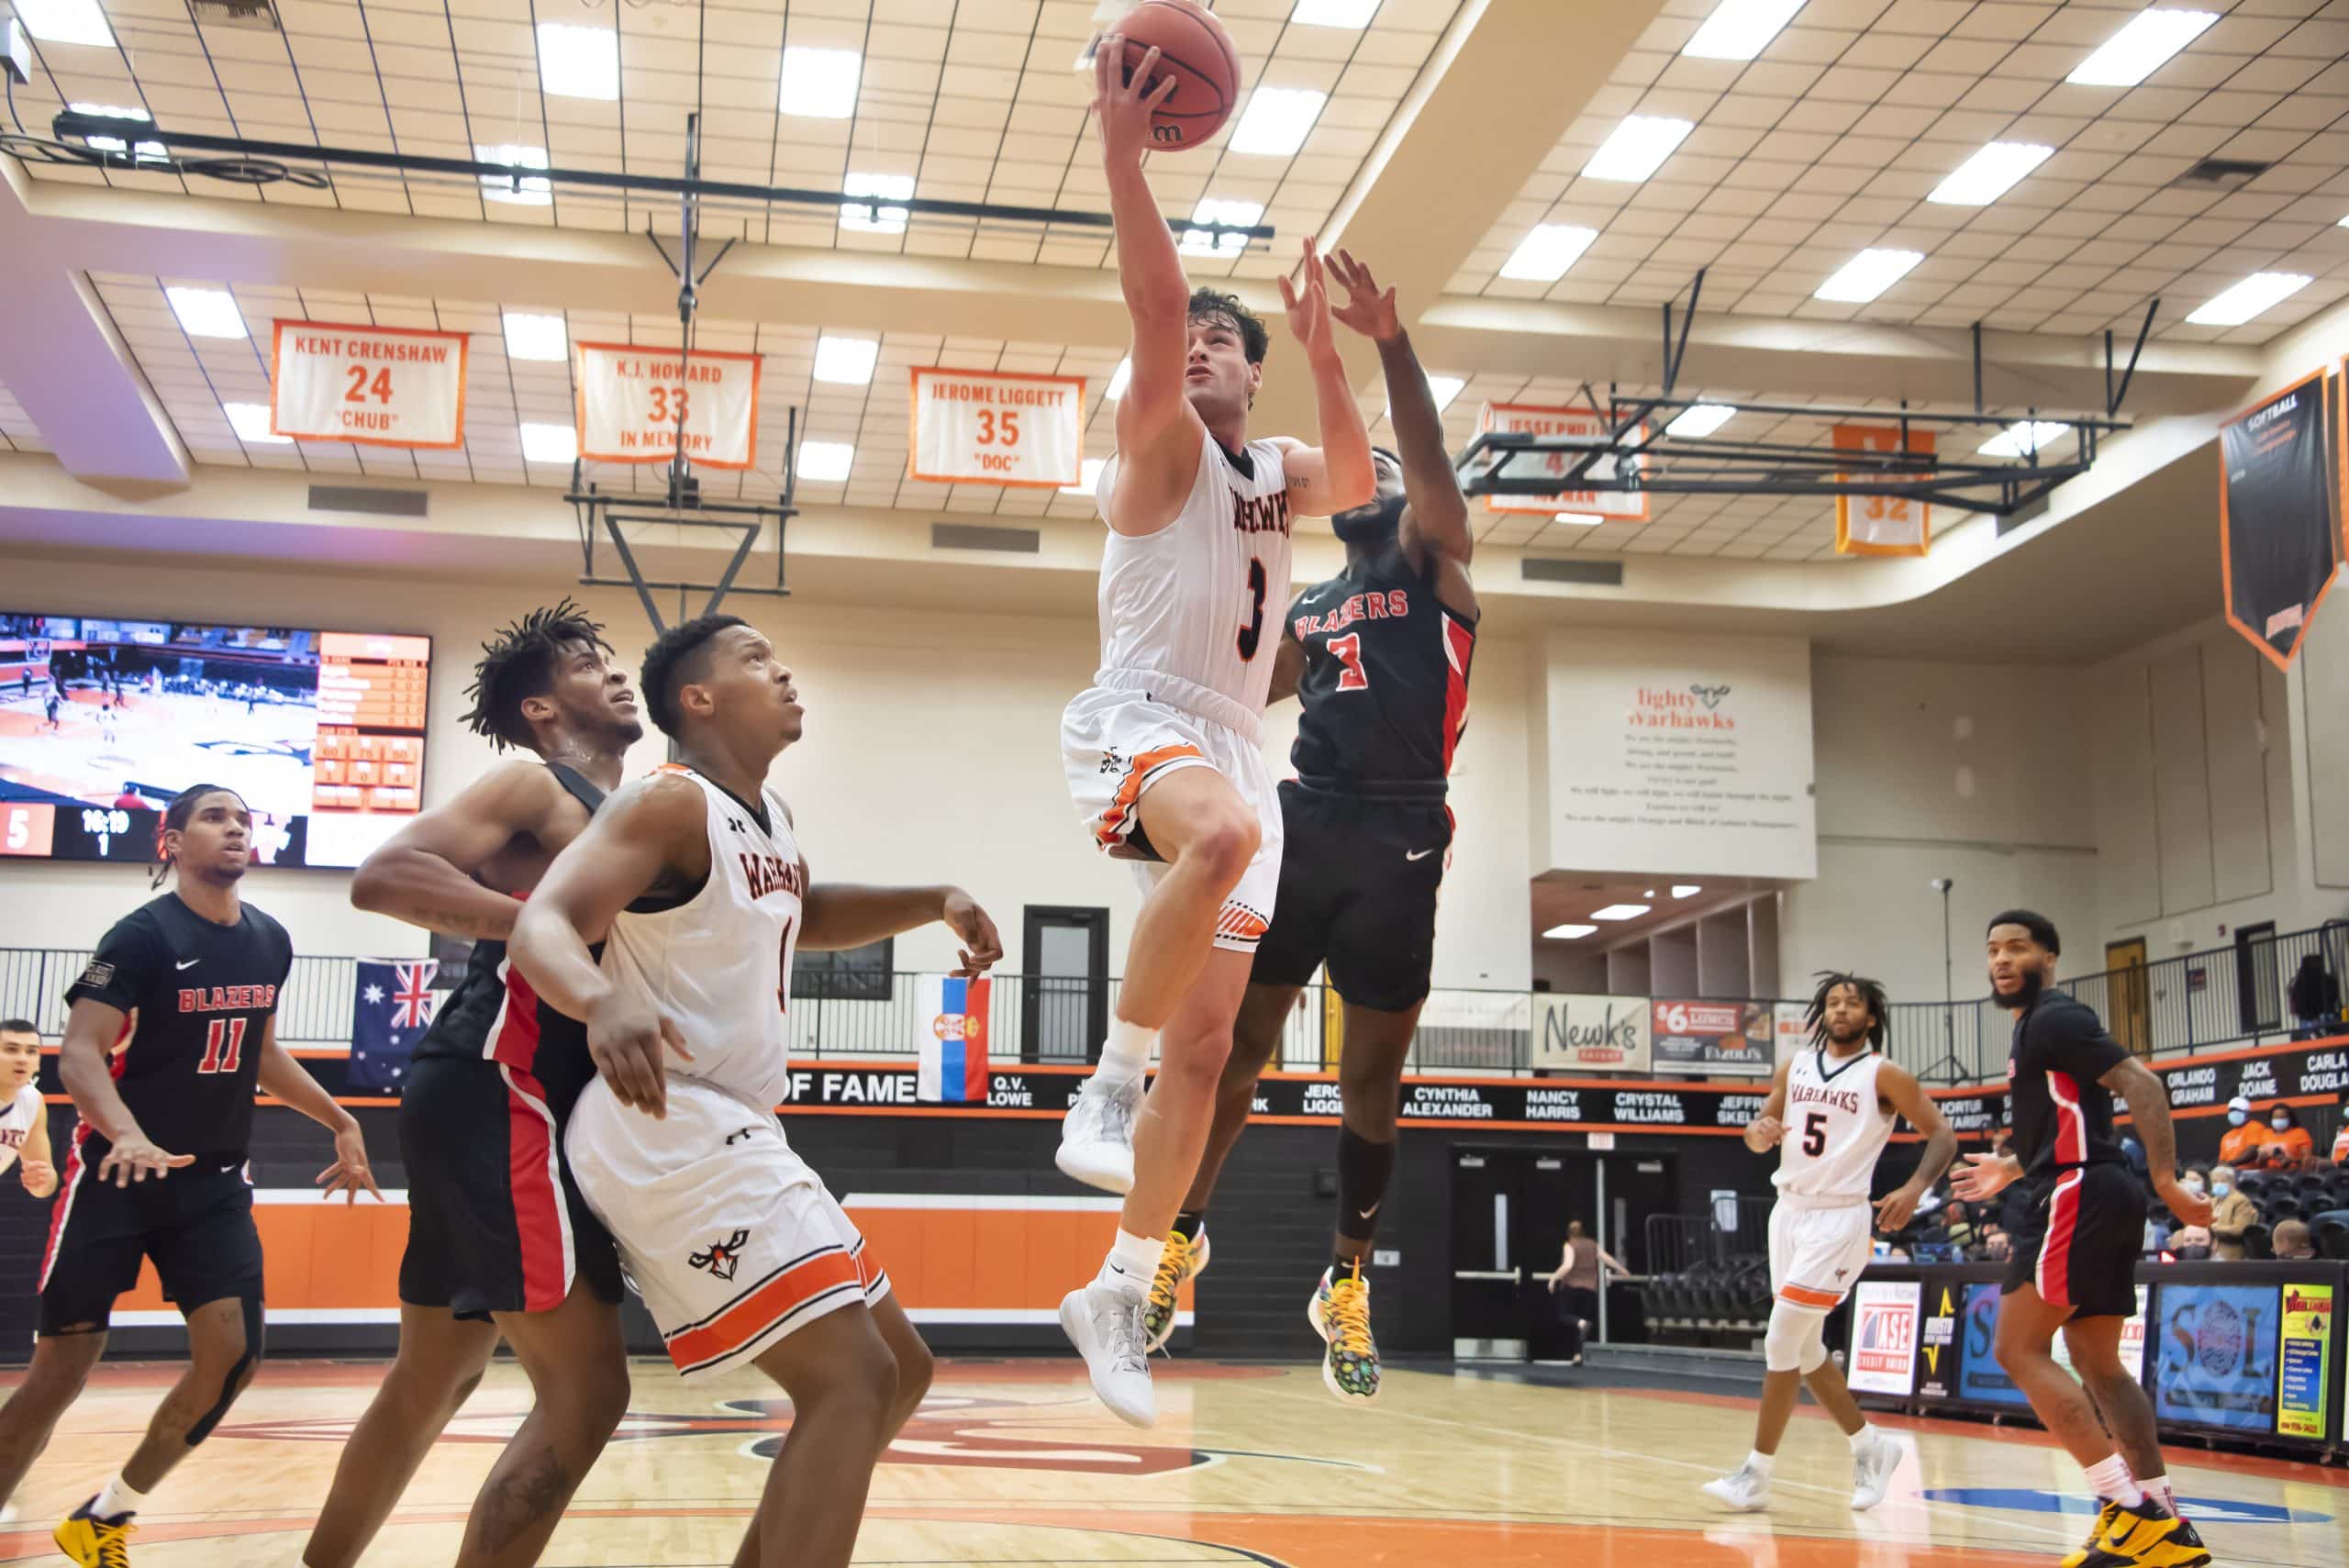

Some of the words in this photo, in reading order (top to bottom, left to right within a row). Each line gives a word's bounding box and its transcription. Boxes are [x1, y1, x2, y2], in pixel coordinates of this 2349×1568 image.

[295, 337, 342, 356] KENT
[347, 340, 448, 363] CRENSHAW
[618, 360, 644, 378] K.J.
[651, 363, 722, 383] HOWARD
[345, 365, 394, 404] 24
[932, 383, 995, 403] JEROME
[999, 388, 1065, 406] LIGGETT
[648, 385, 689, 424] 33
[2248, 394, 2298, 432] SOFTBALL
[976, 409, 1019, 447] 35
[620, 430, 637, 447] IN
[643, 432, 713, 451] MEMORY
[974, 452, 1020, 472] "DOC"
[7, 809, 29, 849] 5
[98, 833, 109, 856] 1
[178, 984, 275, 1012] BLAZERS
[1544, 1002, 1636, 1053] Newk's
[197, 1018, 247, 1073] 11
[2242, 1061, 2271, 1080] JACK
[2307, 1052, 2348, 1072] CARLA
[994, 1076, 1027, 1091] Q.V.
[2167, 1068, 2216, 1087] ORLANDO
[2300, 1073, 2349, 1092] DOUGLA
[823, 1074, 916, 1103] FAME
[987, 1092, 1032, 1106] LOWE
[1415, 1086, 1479, 1101] CYNTHIA
[1527, 1090, 1578, 1105] NANCY
[2171, 1086, 2215, 1105] GRAHAM
[1403, 1103, 1492, 1117] ALEXANDER
[1616, 1093, 1681, 1107] CRYSTAL
[1526, 1106, 1581, 1120] HARRIS
[1614, 1107, 1685, 1122] WILLIAMS
[1803, 1112, 1827, 1157] 5
